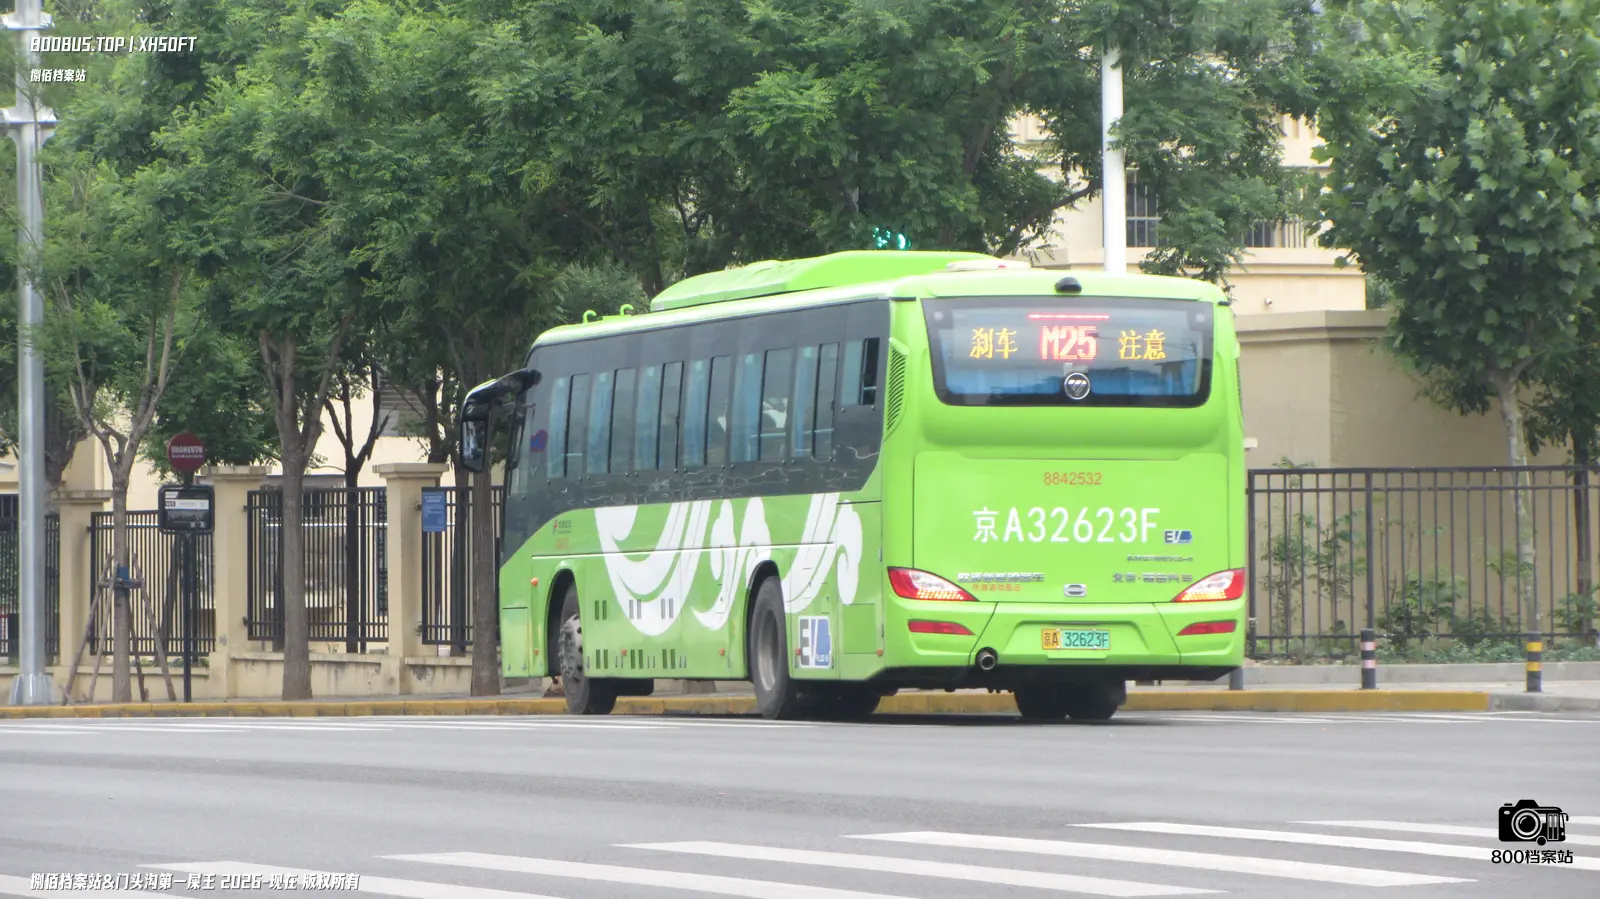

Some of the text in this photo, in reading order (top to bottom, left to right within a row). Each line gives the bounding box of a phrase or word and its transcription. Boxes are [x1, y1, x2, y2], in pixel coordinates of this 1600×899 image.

[969, 325, 1167, 361] 刹车 M25 注意
[1043, 472, 1103, 485] 8842532
[972, 506, 1160, 543] 京A32623F
